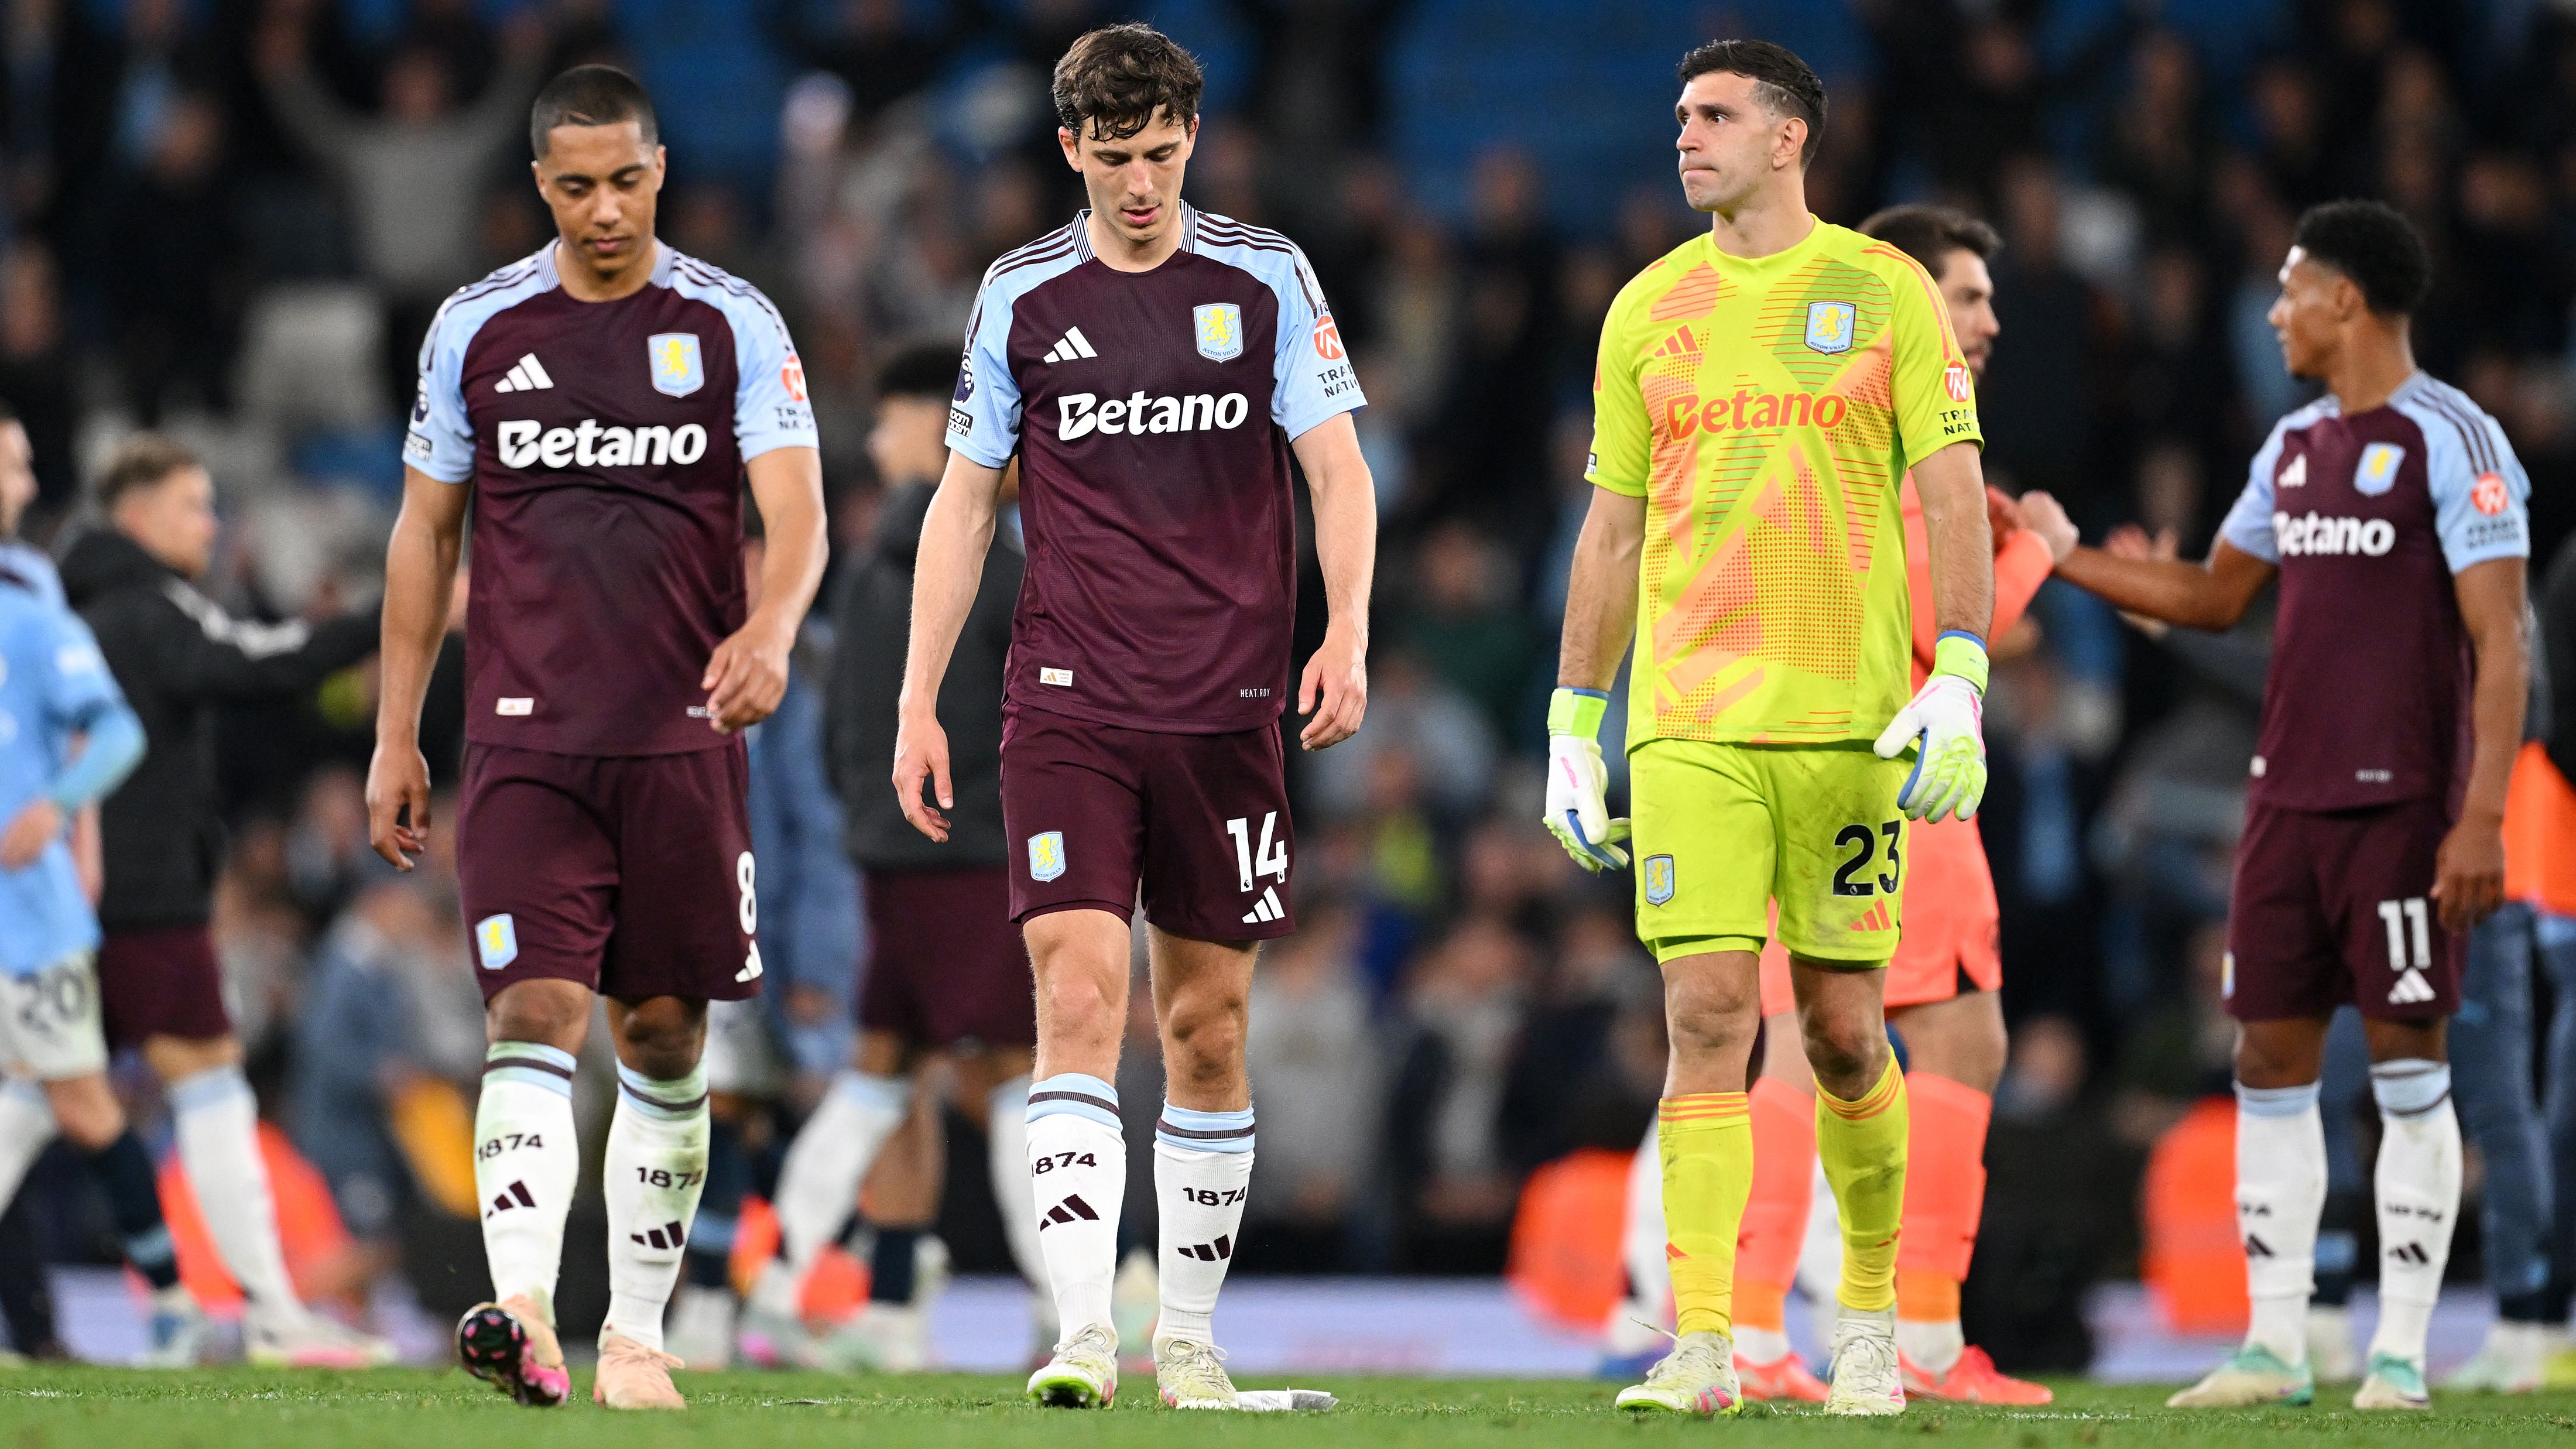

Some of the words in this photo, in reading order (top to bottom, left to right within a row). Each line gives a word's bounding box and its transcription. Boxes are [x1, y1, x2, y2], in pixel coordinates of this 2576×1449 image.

[1202, 348, 1222, 357] ASTON
[1222, 347, 1238, 356] VILLA
[1324, 379, 1358, 398] NATI
[1059, 390, 1249, 441] Betano
[1667, 389, 1847, 441] Betano
[498, 418, 708, 469] Betano
[1227, 811, 1287, 892] 14
[1832, 820, 1901, 896] 23
[737, 850, 758, 935] 8
[2378, 896, 2432, 972] 11
[1031, 1152, 1097, 1178] 874
